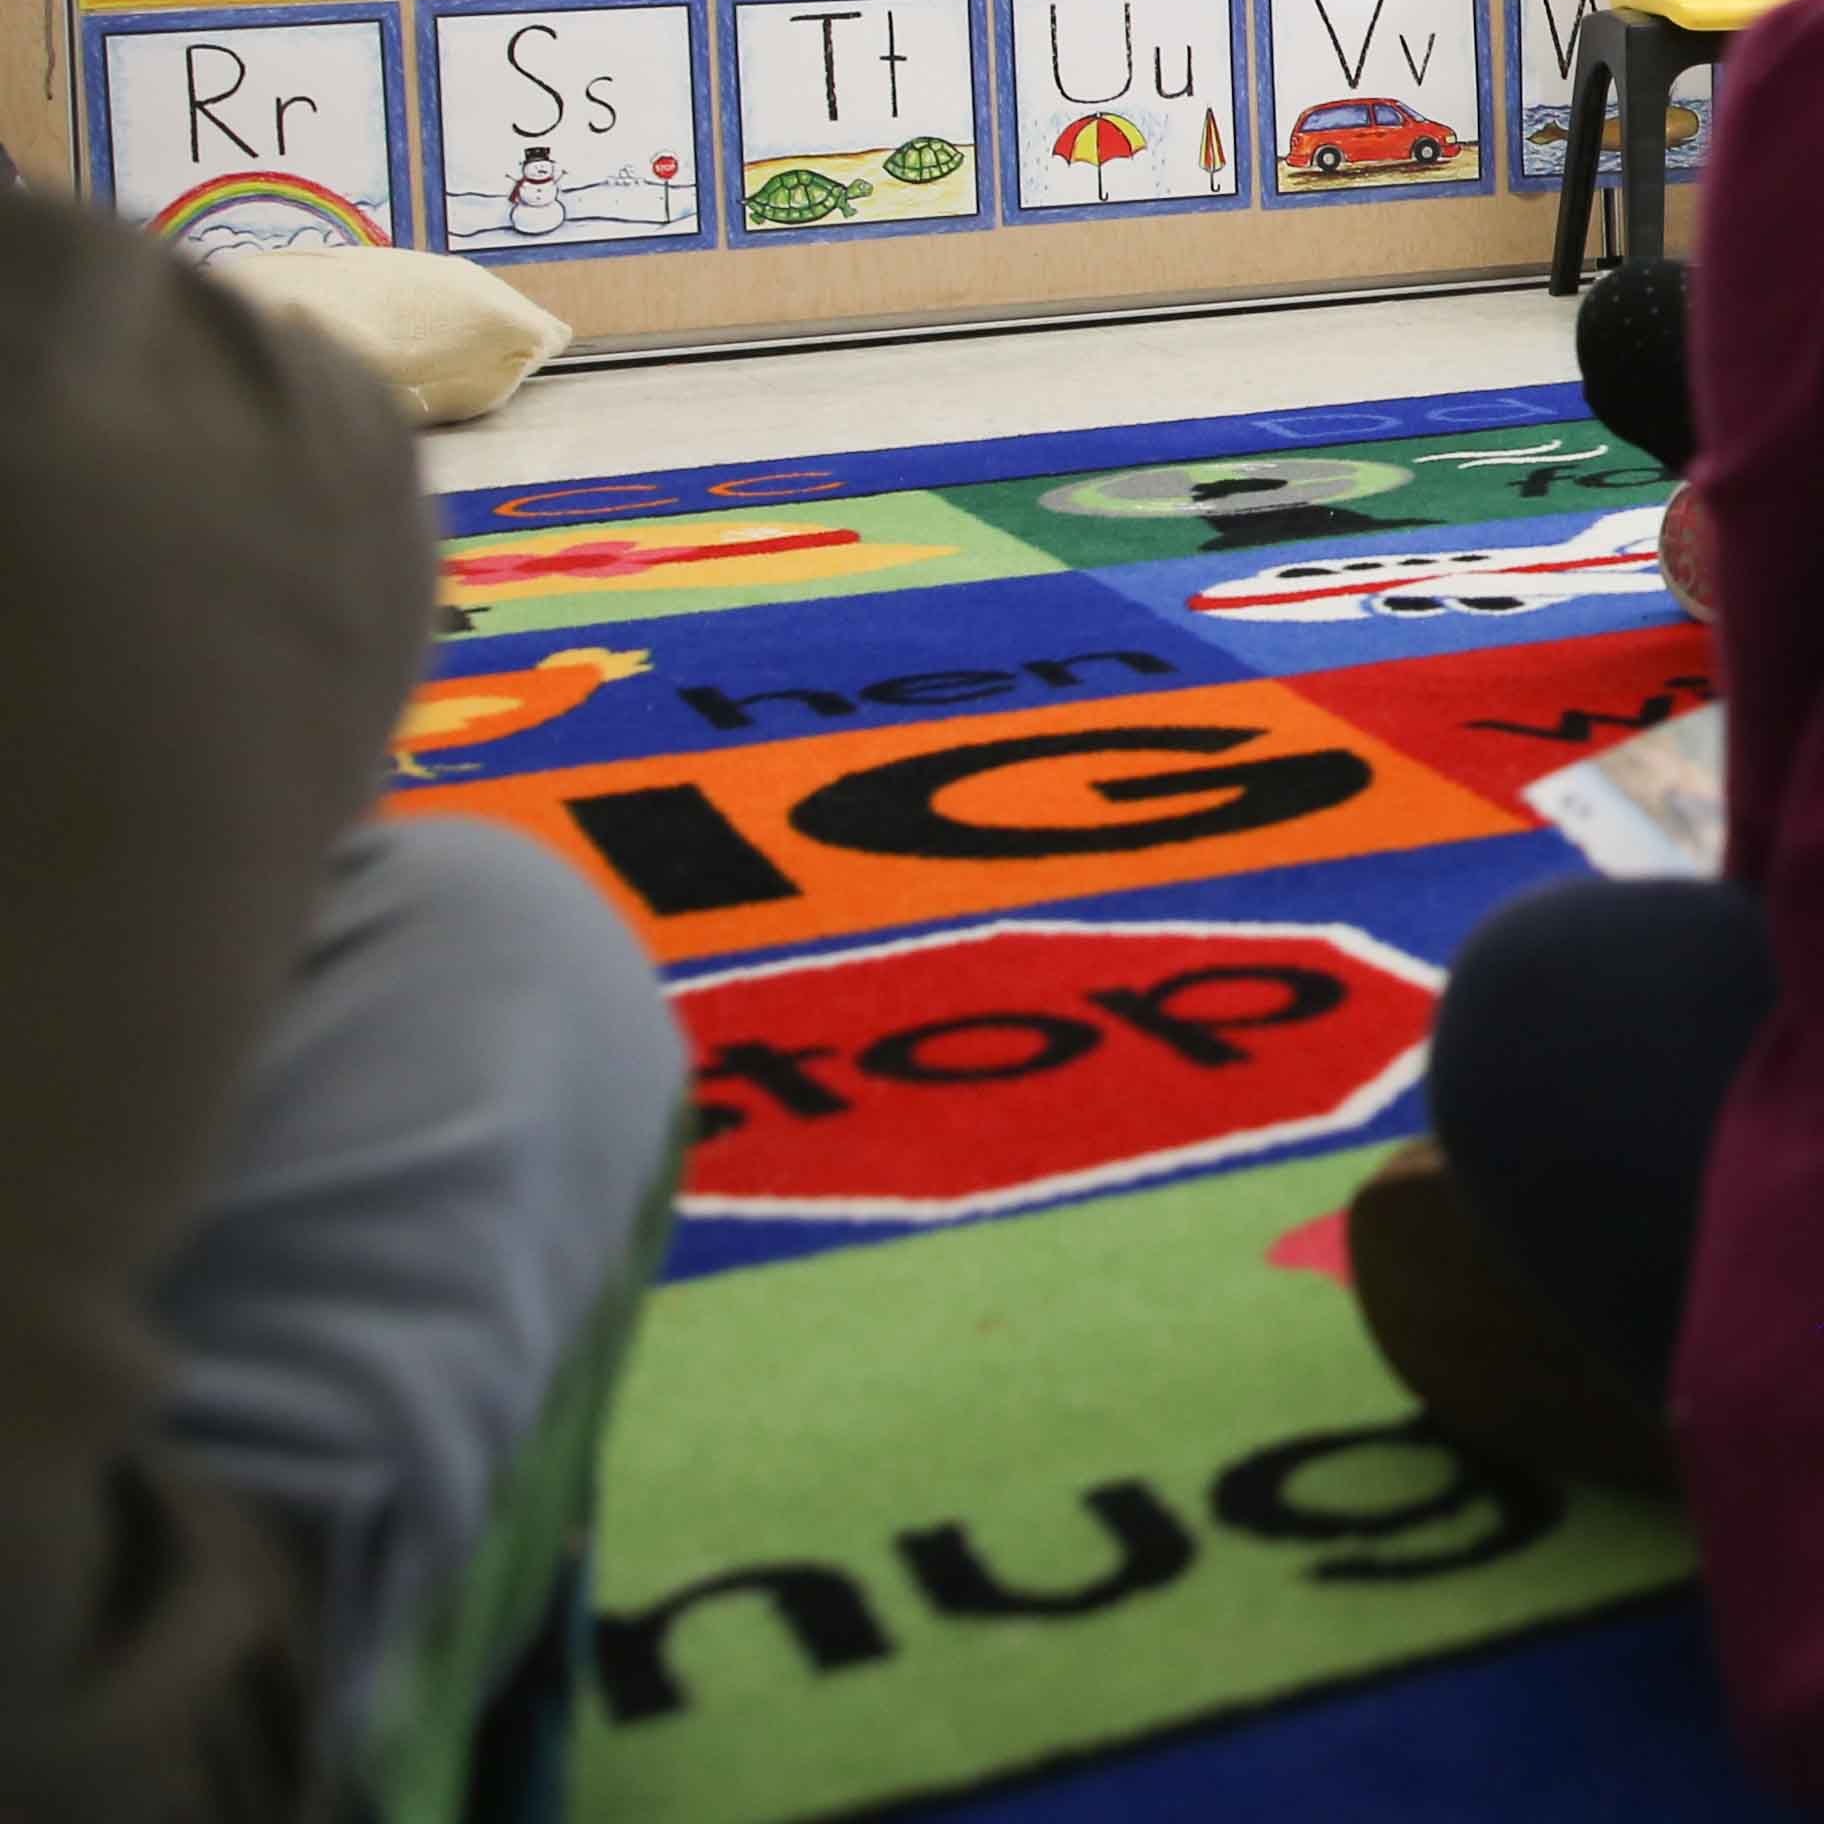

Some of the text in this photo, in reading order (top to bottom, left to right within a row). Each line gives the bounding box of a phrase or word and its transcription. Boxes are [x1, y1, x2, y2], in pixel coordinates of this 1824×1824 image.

[185, 44, 318, 164] Rr
[507, 24, 617, 138] Ss
[790, 10, 908, 122] Tt
[1049, 2, 1196, 105] Uu
[676, 651, 1179, 731] hen
